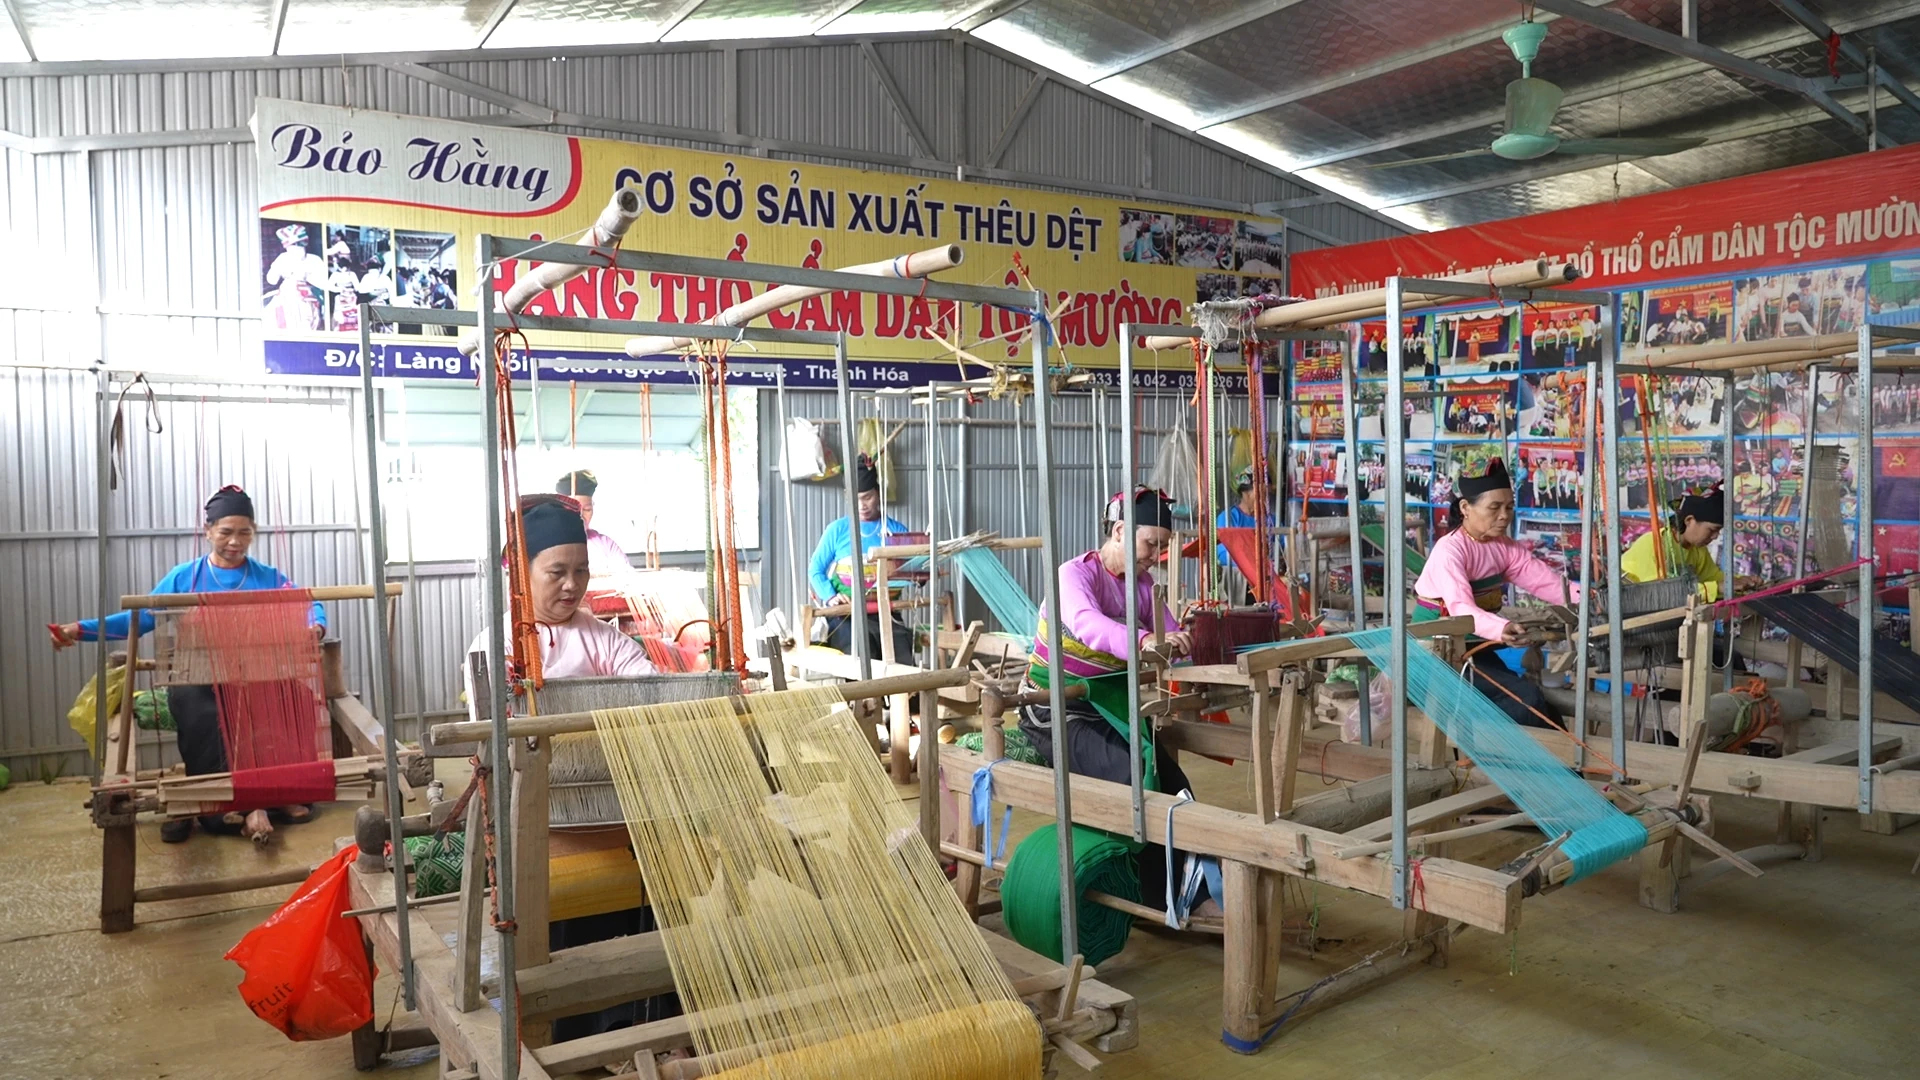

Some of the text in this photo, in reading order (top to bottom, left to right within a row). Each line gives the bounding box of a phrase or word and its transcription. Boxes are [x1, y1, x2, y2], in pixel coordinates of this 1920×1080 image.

[271, 124, 552, 201] Bảo Hằng
[689, 161, 743, 221] SỞ
[756, 169, 835, 229] SẢN
[848, 183, 944, 238] XUẤT
[954, 200, 1036, 247] THÊU
[1047, 207, 1102, 262] DỆT
[1601, 231, 1643, 276] THỔ
[1650, 225, 1704, 270] CẨM
[1712, 221, 1765, 263] DÂN
[1774, 212, 1826, 258] TỘC
[395, 352, 461, 374] Làng
[873, 367, 909, 381] Hóa
[1144, 374, 1167, 386] 042
